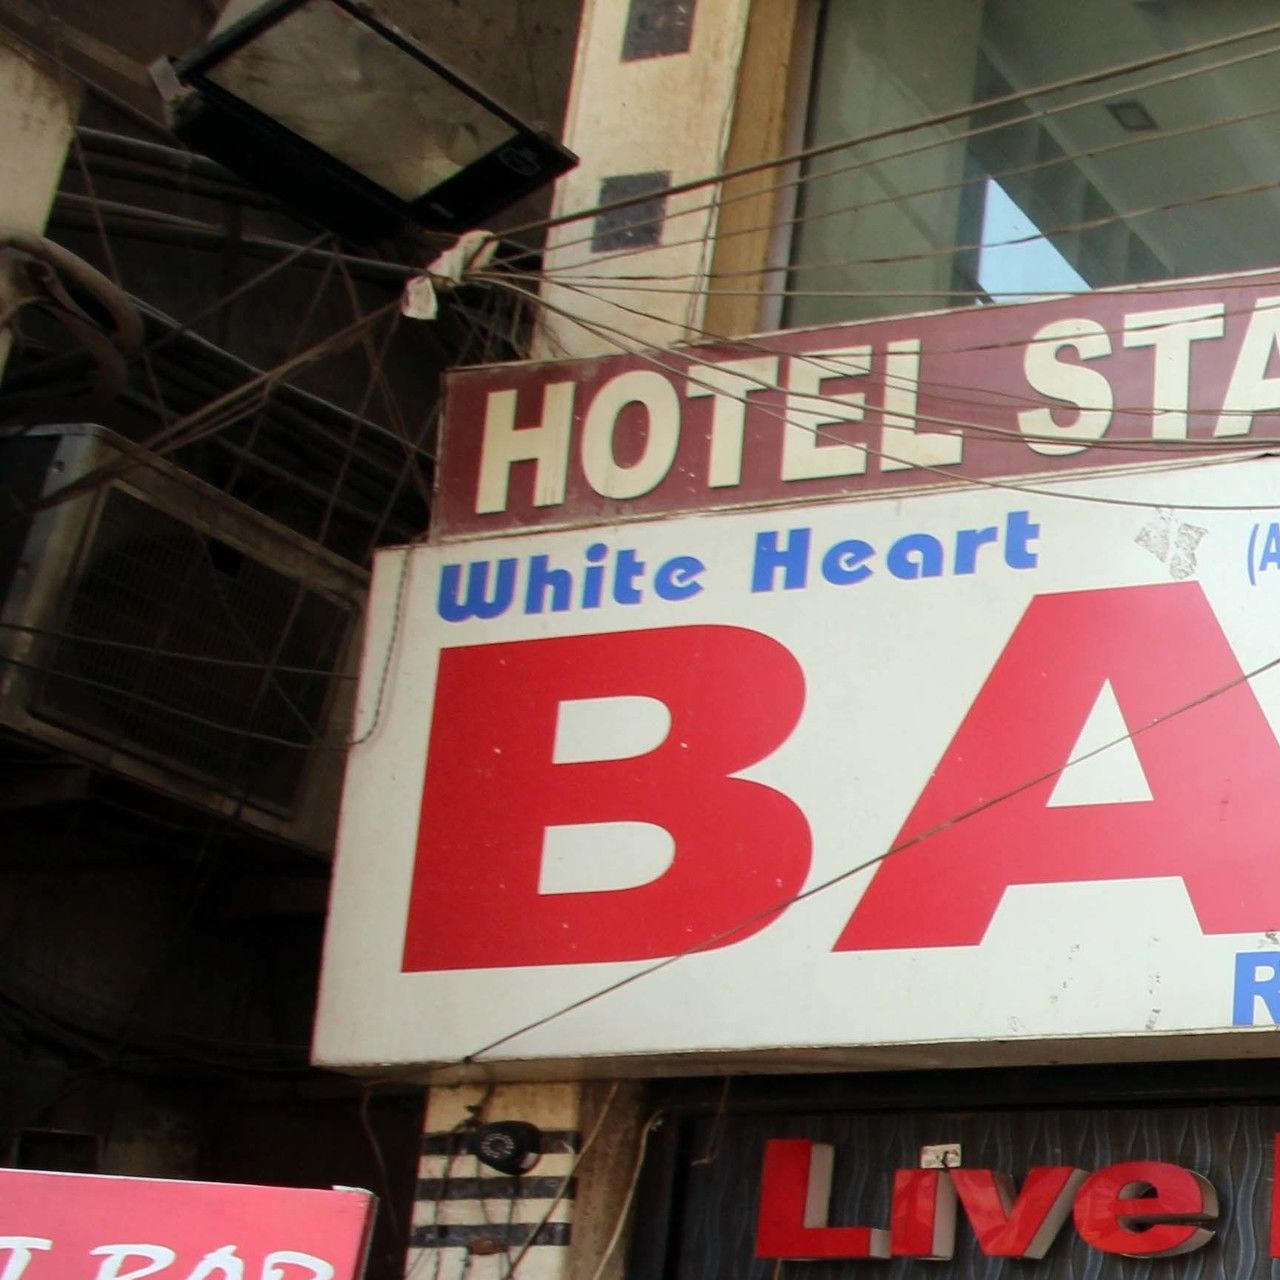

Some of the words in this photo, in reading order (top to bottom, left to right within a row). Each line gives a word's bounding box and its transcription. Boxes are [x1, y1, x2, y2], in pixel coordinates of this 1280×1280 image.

[475, 339, 963, 514] HOTEL
[436, 544, 705, 622] White
[751, 510, 1042, 593] Heart
[754, 1137, 1218, 1261] Live
